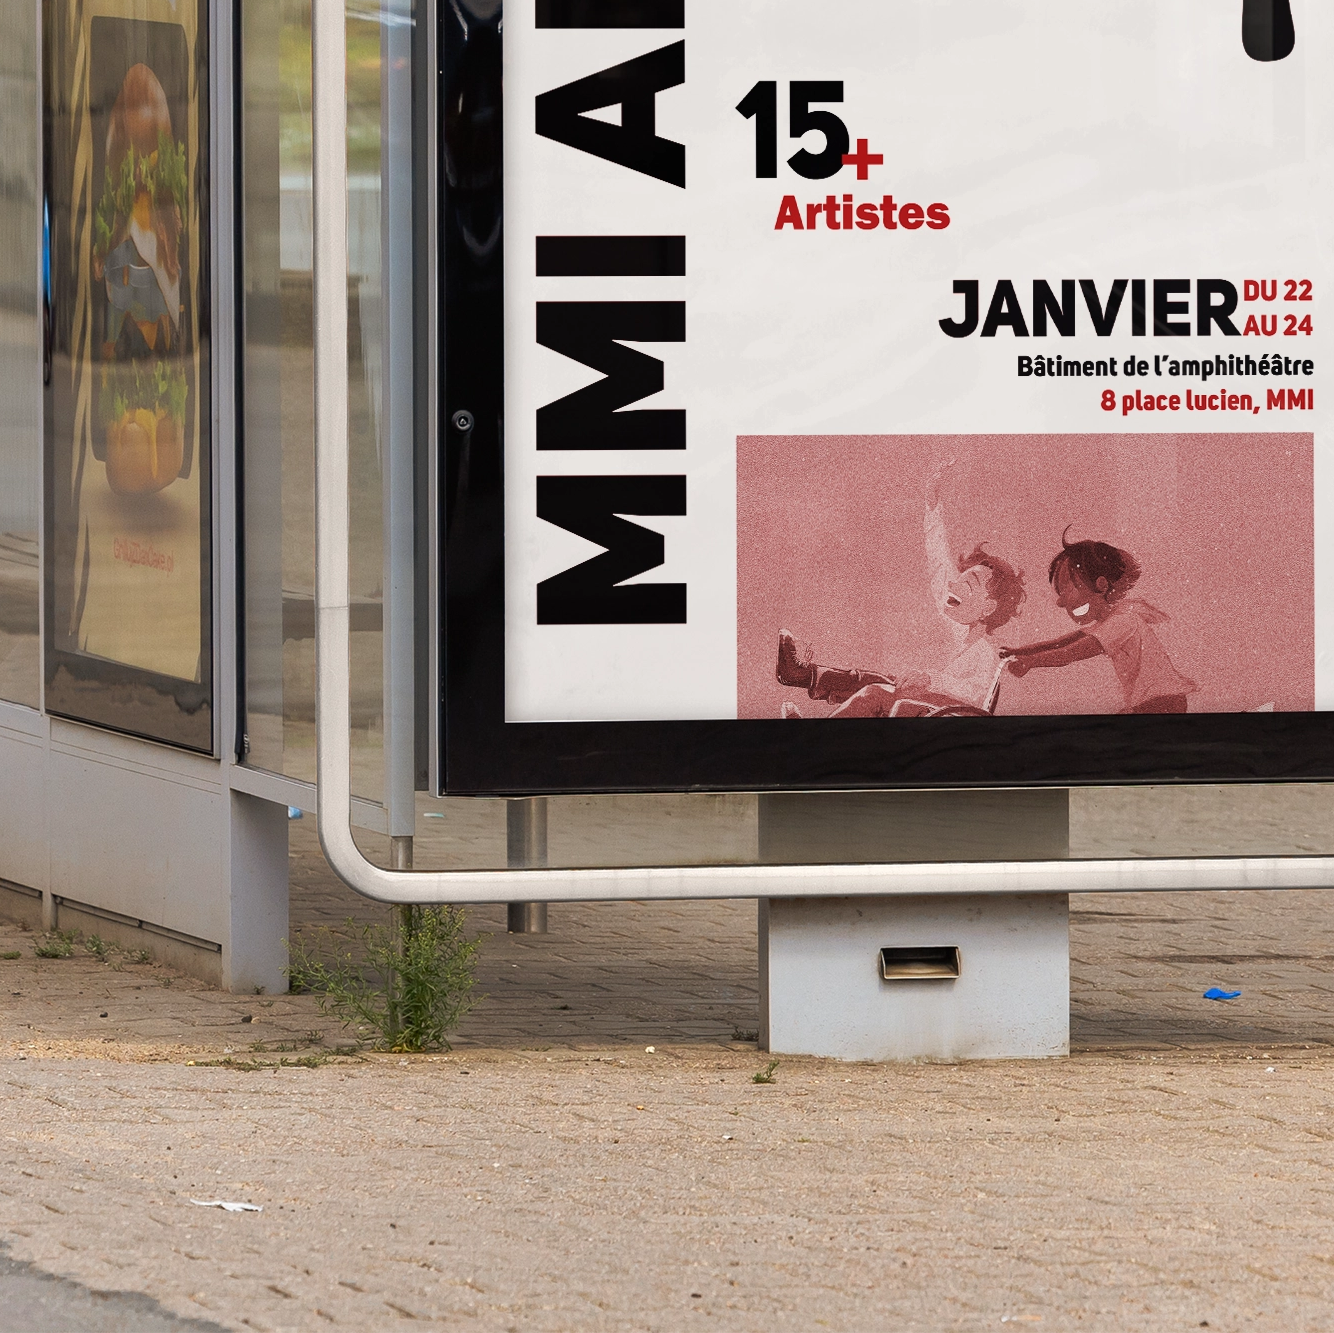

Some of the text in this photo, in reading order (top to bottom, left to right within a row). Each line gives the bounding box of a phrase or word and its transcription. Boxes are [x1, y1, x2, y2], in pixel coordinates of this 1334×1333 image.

[735, 80, 884, 181] 15+
[774, 193, 952, 231] Artistes
[1243, 278, 1313, 302] DU 22
[938, 278, 1242, 339] JANVIER
[1242, 313, 1314, 337] AU 24
[1017, 353, 1314, 382] Bâtiment de l'amphithéâtre
[1100, 388, 1314, 417] 8 place lucien, MMI
[534, 235, 687, 626] MMI
